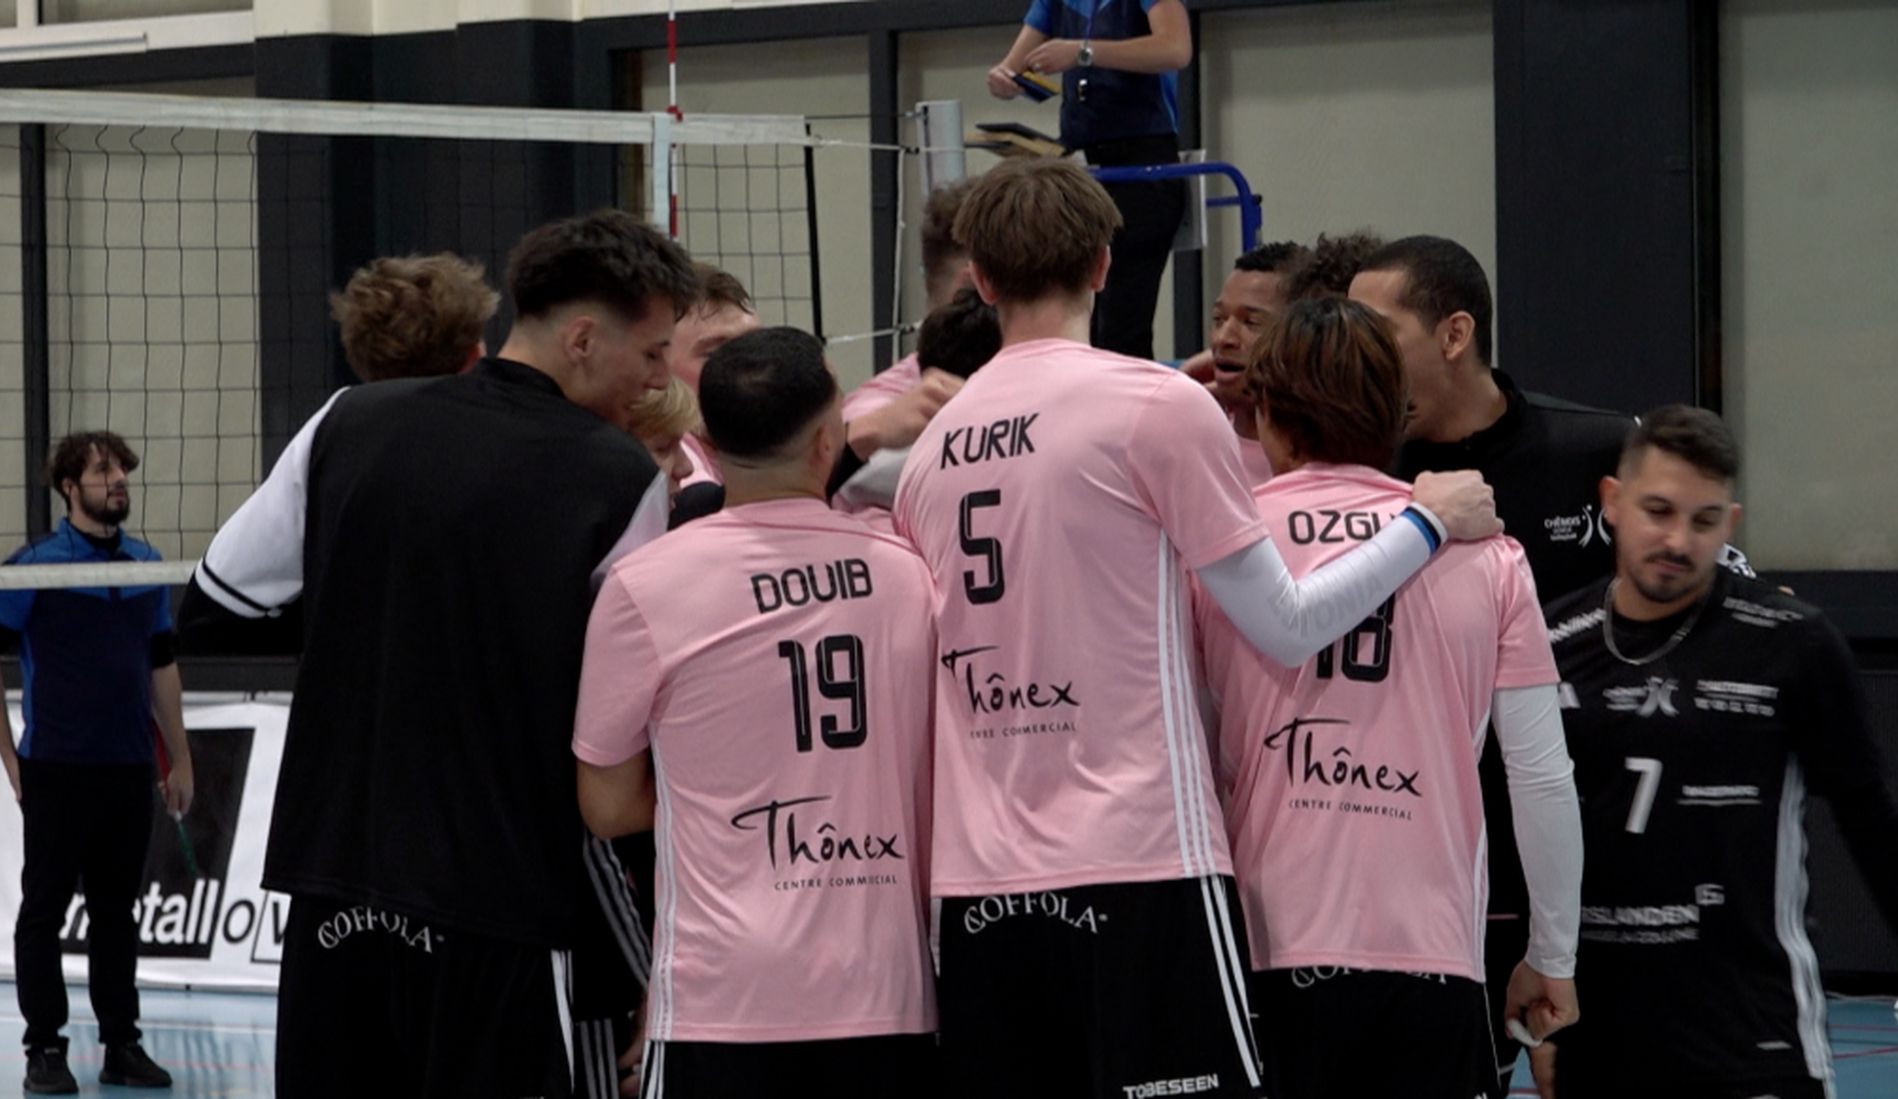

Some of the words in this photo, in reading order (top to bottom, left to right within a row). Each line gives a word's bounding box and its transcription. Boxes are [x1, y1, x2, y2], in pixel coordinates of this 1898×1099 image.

[940, 413, 1040, 470] KURIK
[959, 489, 1005, 605] 5
[750, 558, 873, 614] DOUIB
[778, 634, 868, 753] 19
[941, 645, 1081, 714] Thônex
[1001, 721, 1077, 738] COMERCIAL
[1264, 717, 1423, 798] Thônex
[1288, 799, 1331, 811] CENTRE
[1338, 801, 1412, 821] COMMERCIAL
[1625, 757, 1663, 834] 7
[731, 796, 906, 870] Thônex
[774, 879, 821, 891] CENTRE
[963, 891, 1099, 934] COFFOLA
